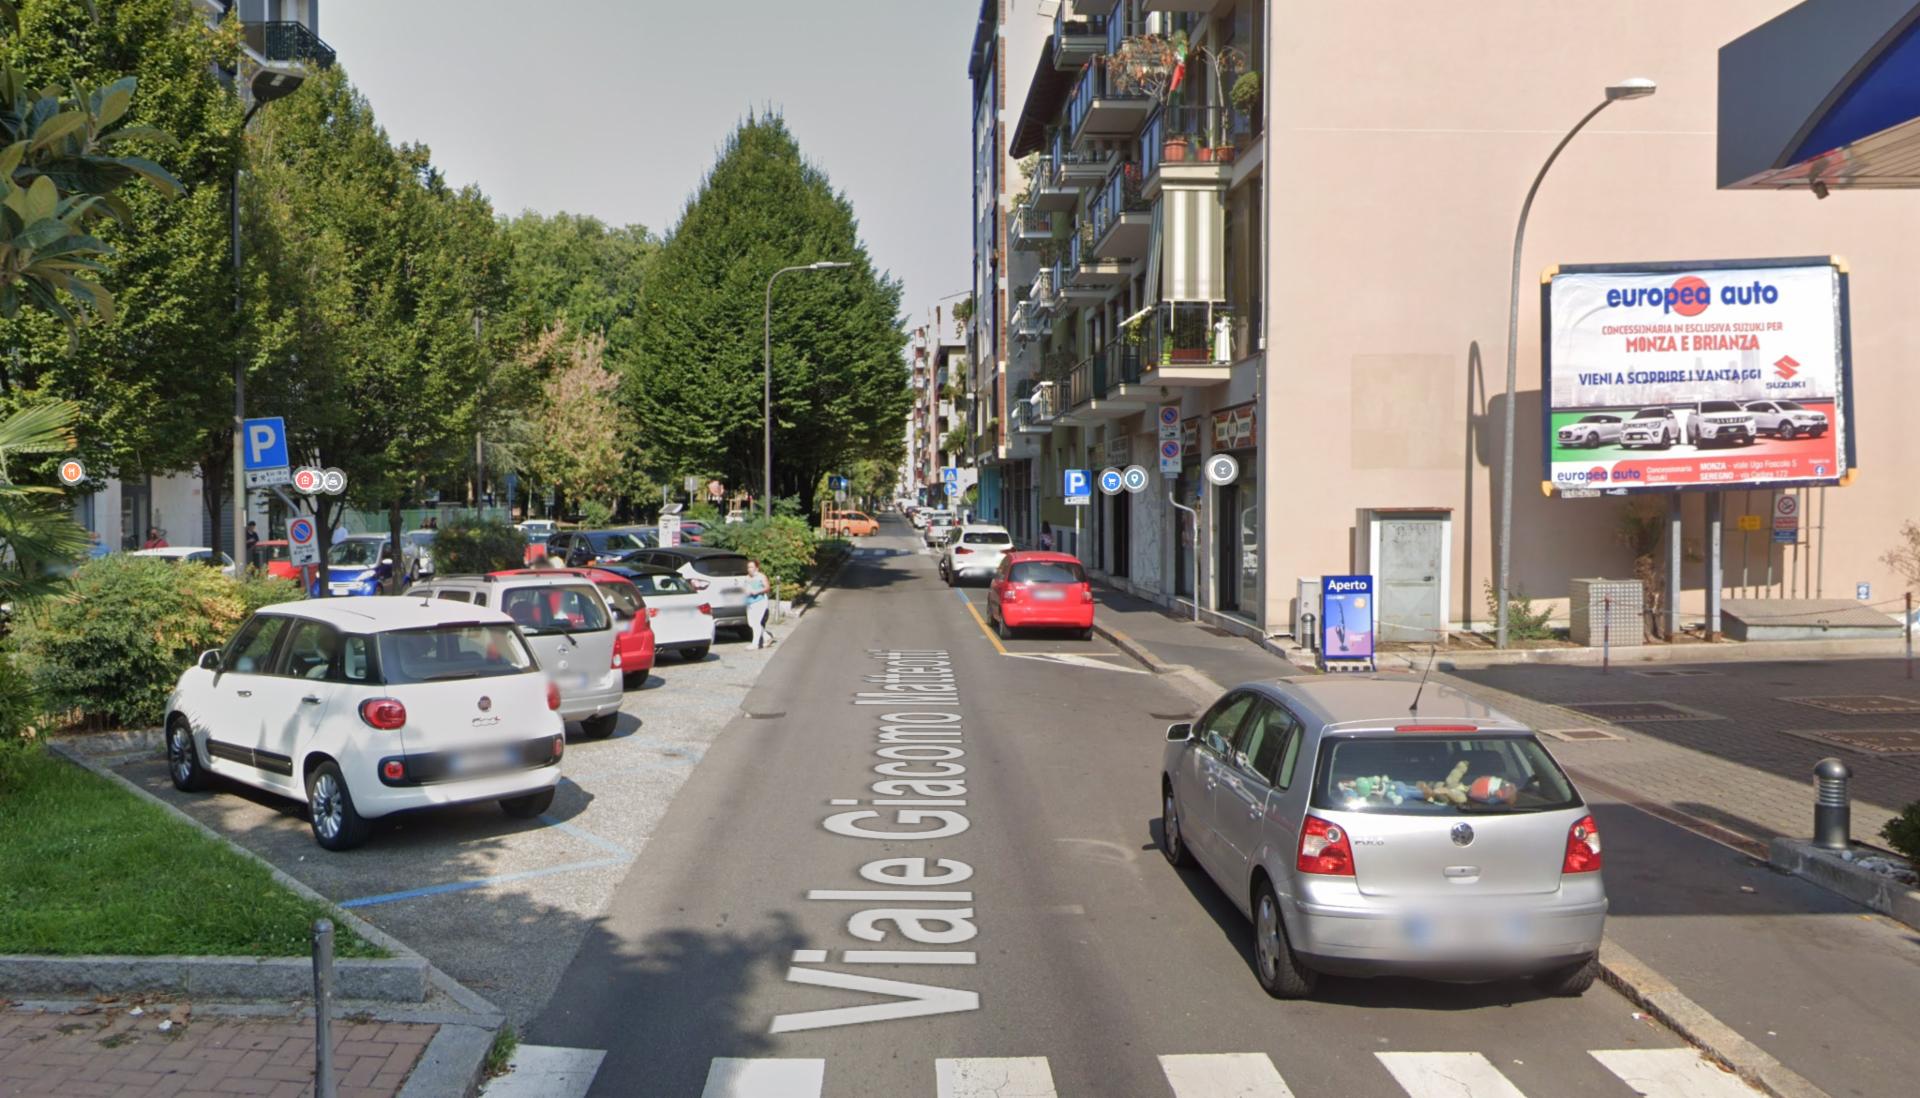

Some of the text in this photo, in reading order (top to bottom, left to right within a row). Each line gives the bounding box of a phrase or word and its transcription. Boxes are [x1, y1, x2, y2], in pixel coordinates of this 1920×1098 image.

[1606, 281, 1779, 315] europea auto
[1602, 321, 1783, 336] CONCESSIONARIA IN ESCLUSIVA SUZUKI PER
[1626, 334, 1760, 353] MONZA E BRIANZA
[1578, 369, 1762, 386] VIENI A SCOPRIRE I VANTAGGI
[1766, 381, 1806, 390] SUZUKI
[249, 425, 276, 463] P
[1700, 462, 1727, 471] MONZA
[1070, 472, 1086, 494] P
[1557, 468, 1641, 485] europea auto
[1328, 579, 1367, 593] Aperto
